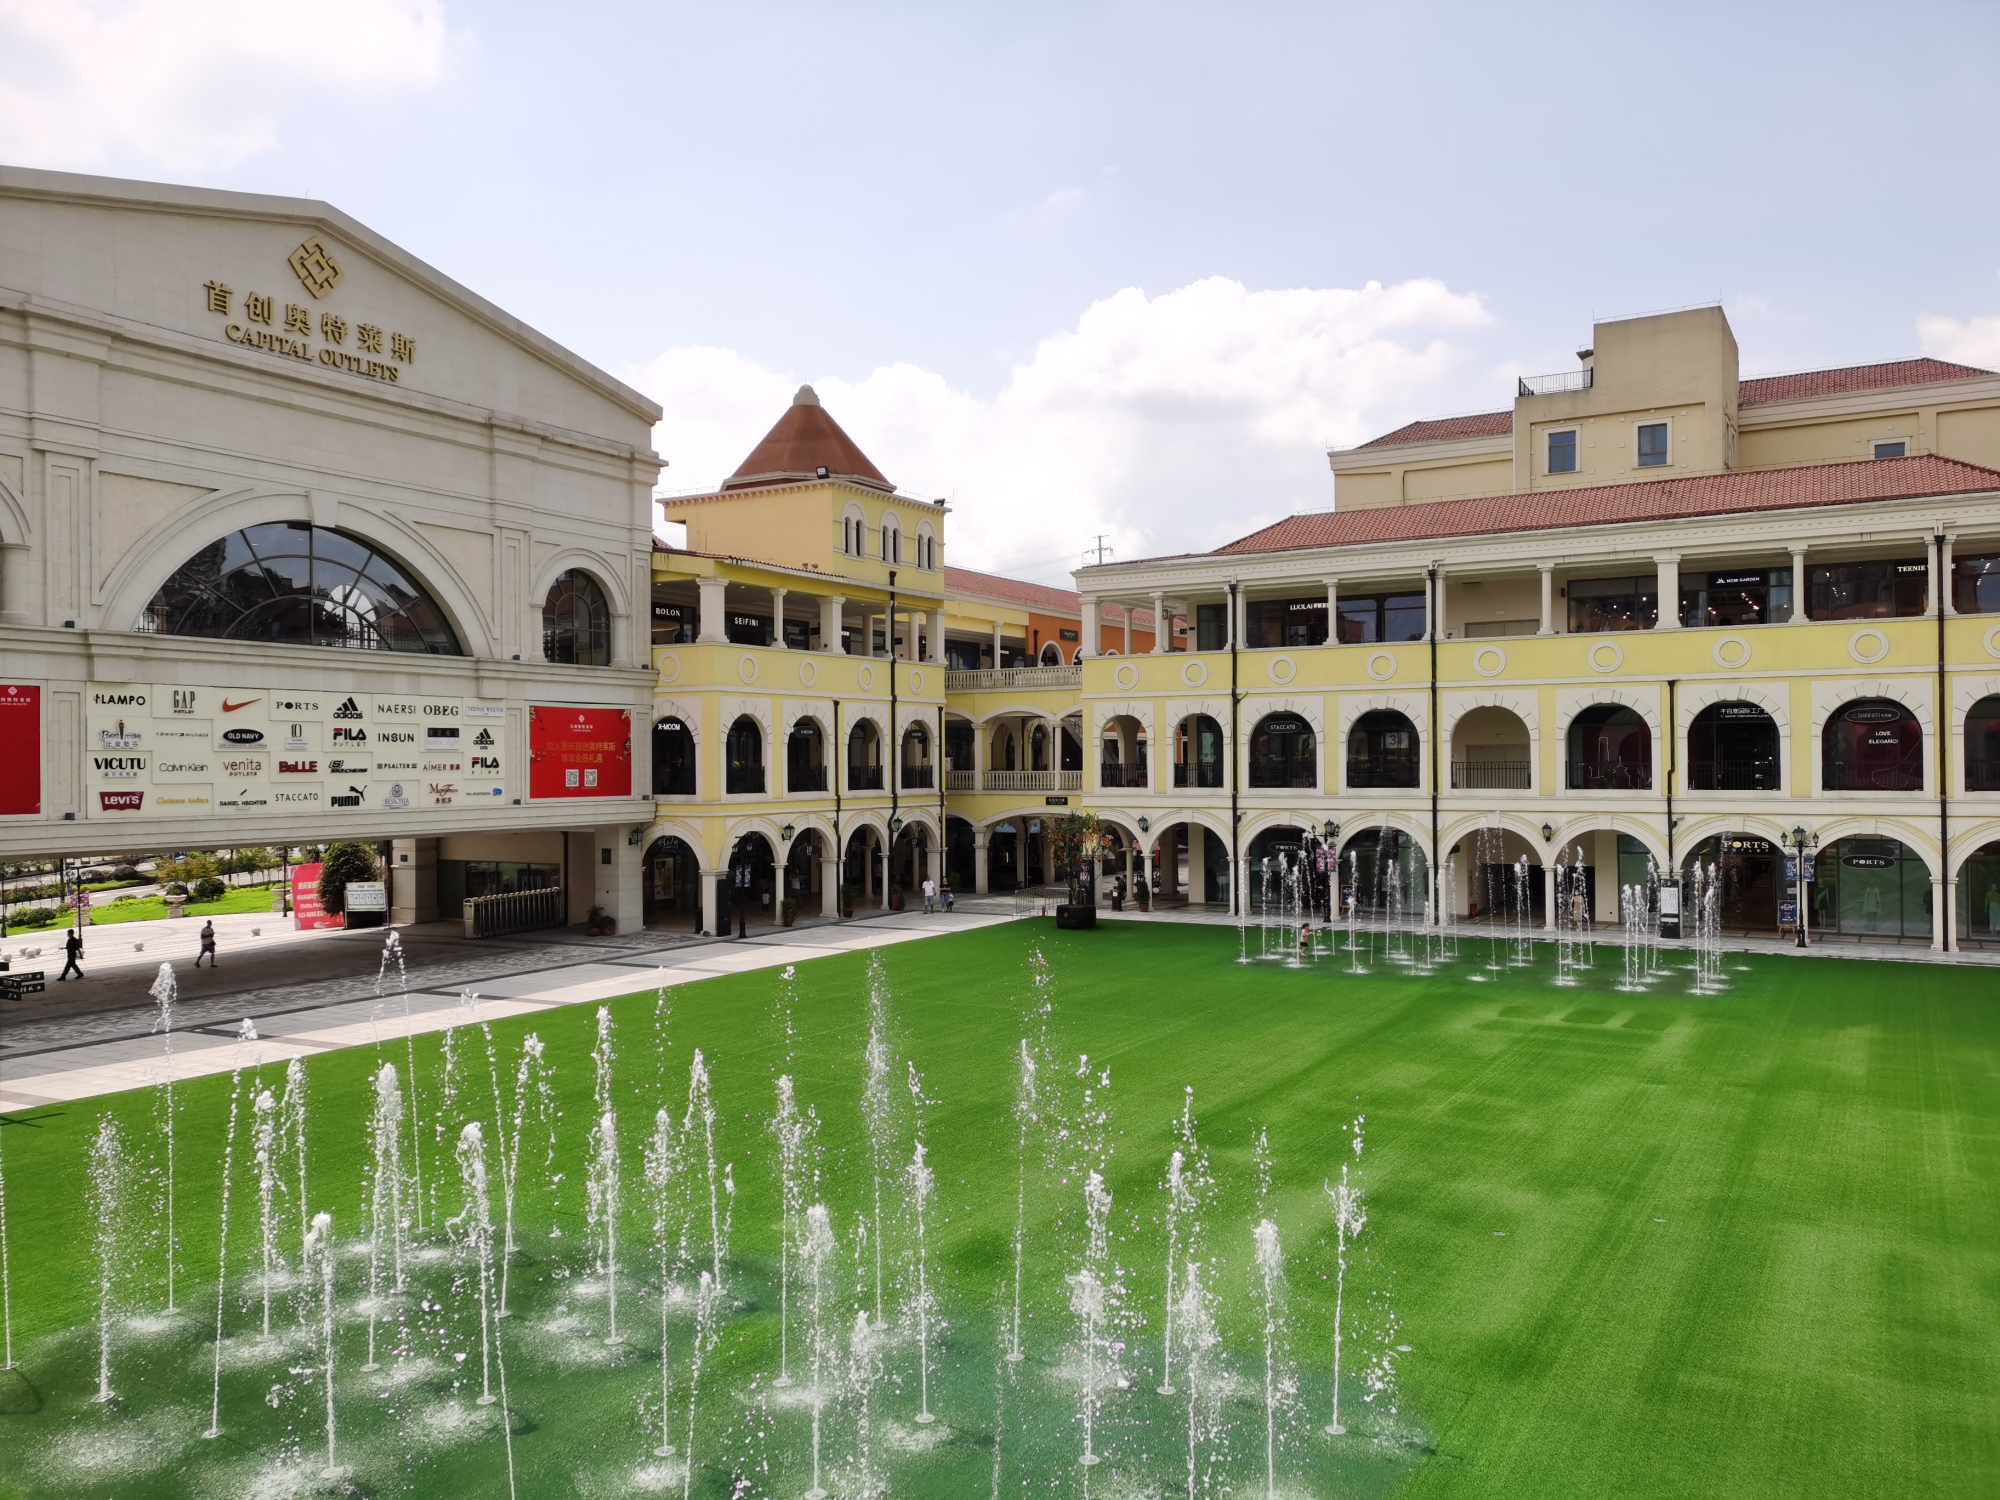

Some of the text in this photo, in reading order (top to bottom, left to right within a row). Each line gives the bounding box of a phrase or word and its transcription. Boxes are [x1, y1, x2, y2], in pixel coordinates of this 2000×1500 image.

[203, 279, 416, 365] 首创奥特莱斯
[225, 323, 400, 382] CAPITAL OUTLETS
[655, 607, 681, 617] BOLON
[734, 617, 759, 627] SEIFINI
[101, 694, 146, 706] LAMPO
[173, 689, 196, 709] GAP
[276, 701, 319, 711] PORTS
[377, 704, 416, 714] NAERSI
[332, 711, 364, 720] adidas
[333, 728, 367, 740] FILA
[378, 733, 415, 742] INSUN
[94, 757, 146, 770] VICUTU
[159, 763, 209, 772] Calvin Klein
[223, 758, 262, 771] venita
[472, 757, 499, 769] FILA
[275, 793, 319, 802] STACCATO
[331, 796, 360, 807] PUMA
[1723, 840, 1769, 849] PORTS
